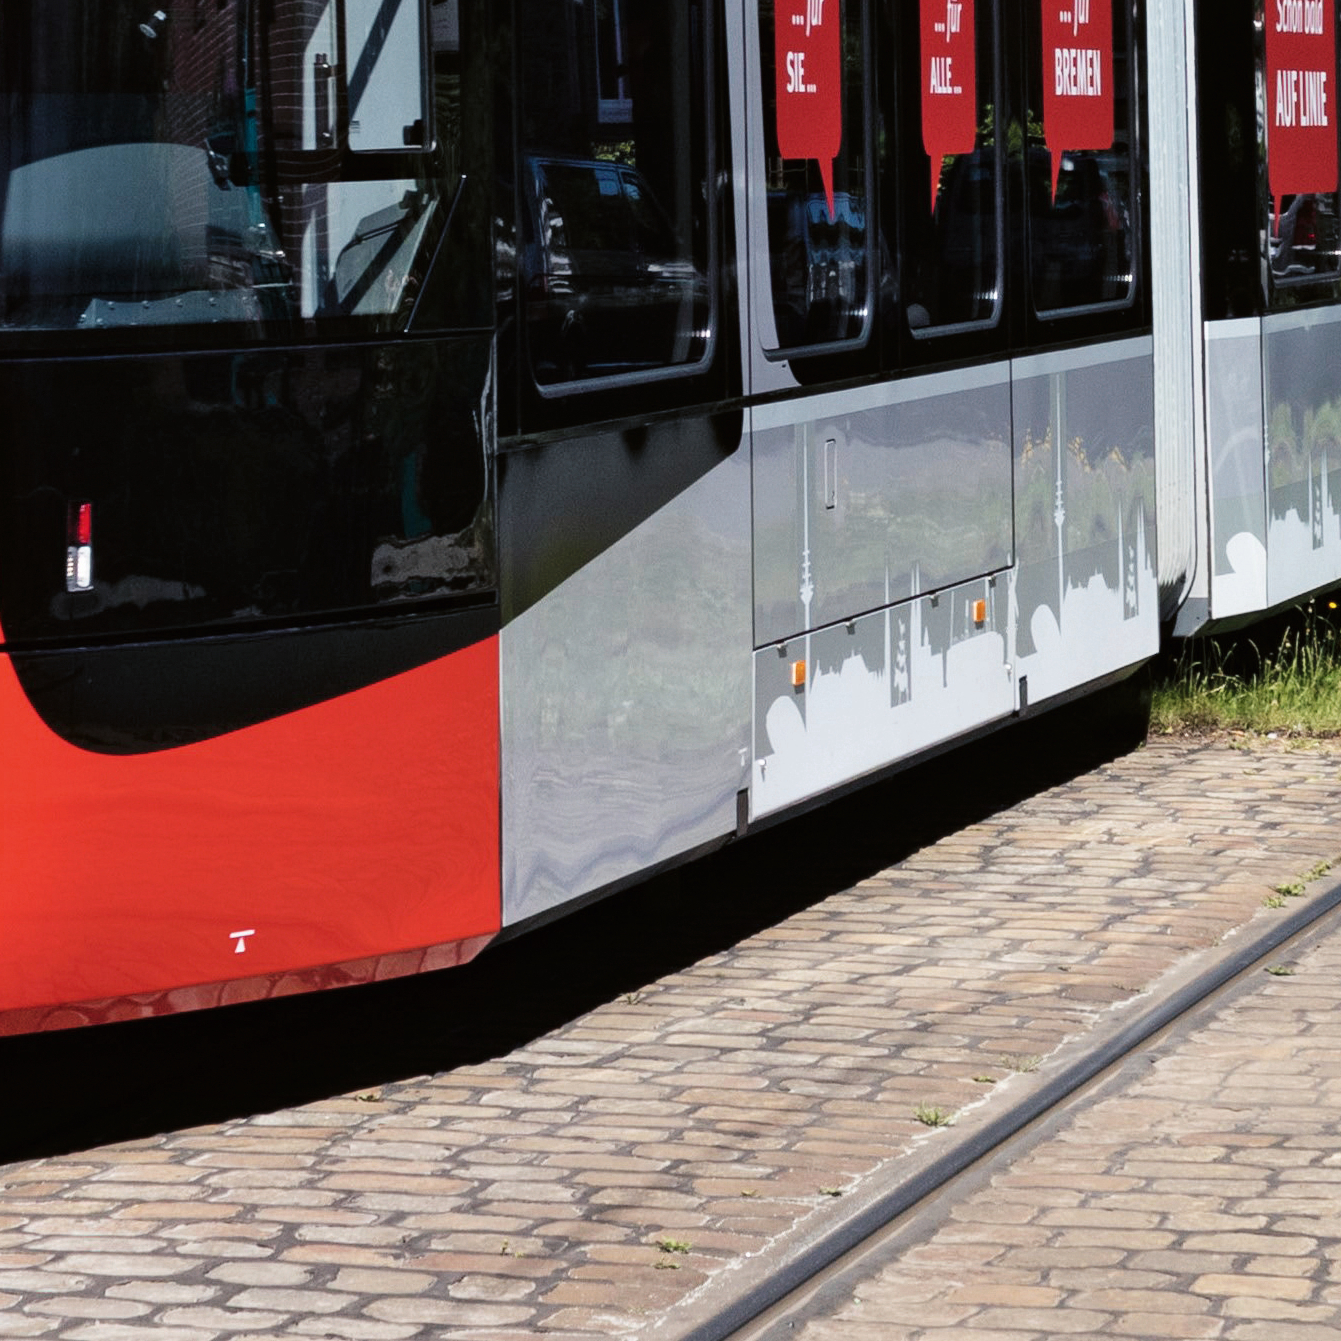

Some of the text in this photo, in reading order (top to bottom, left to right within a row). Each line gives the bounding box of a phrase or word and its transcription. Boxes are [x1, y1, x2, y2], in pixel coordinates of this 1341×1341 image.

[1054, 48, 1101, 96] BREMEN
[1276, 70, 1328, 127] AUF LINIE
